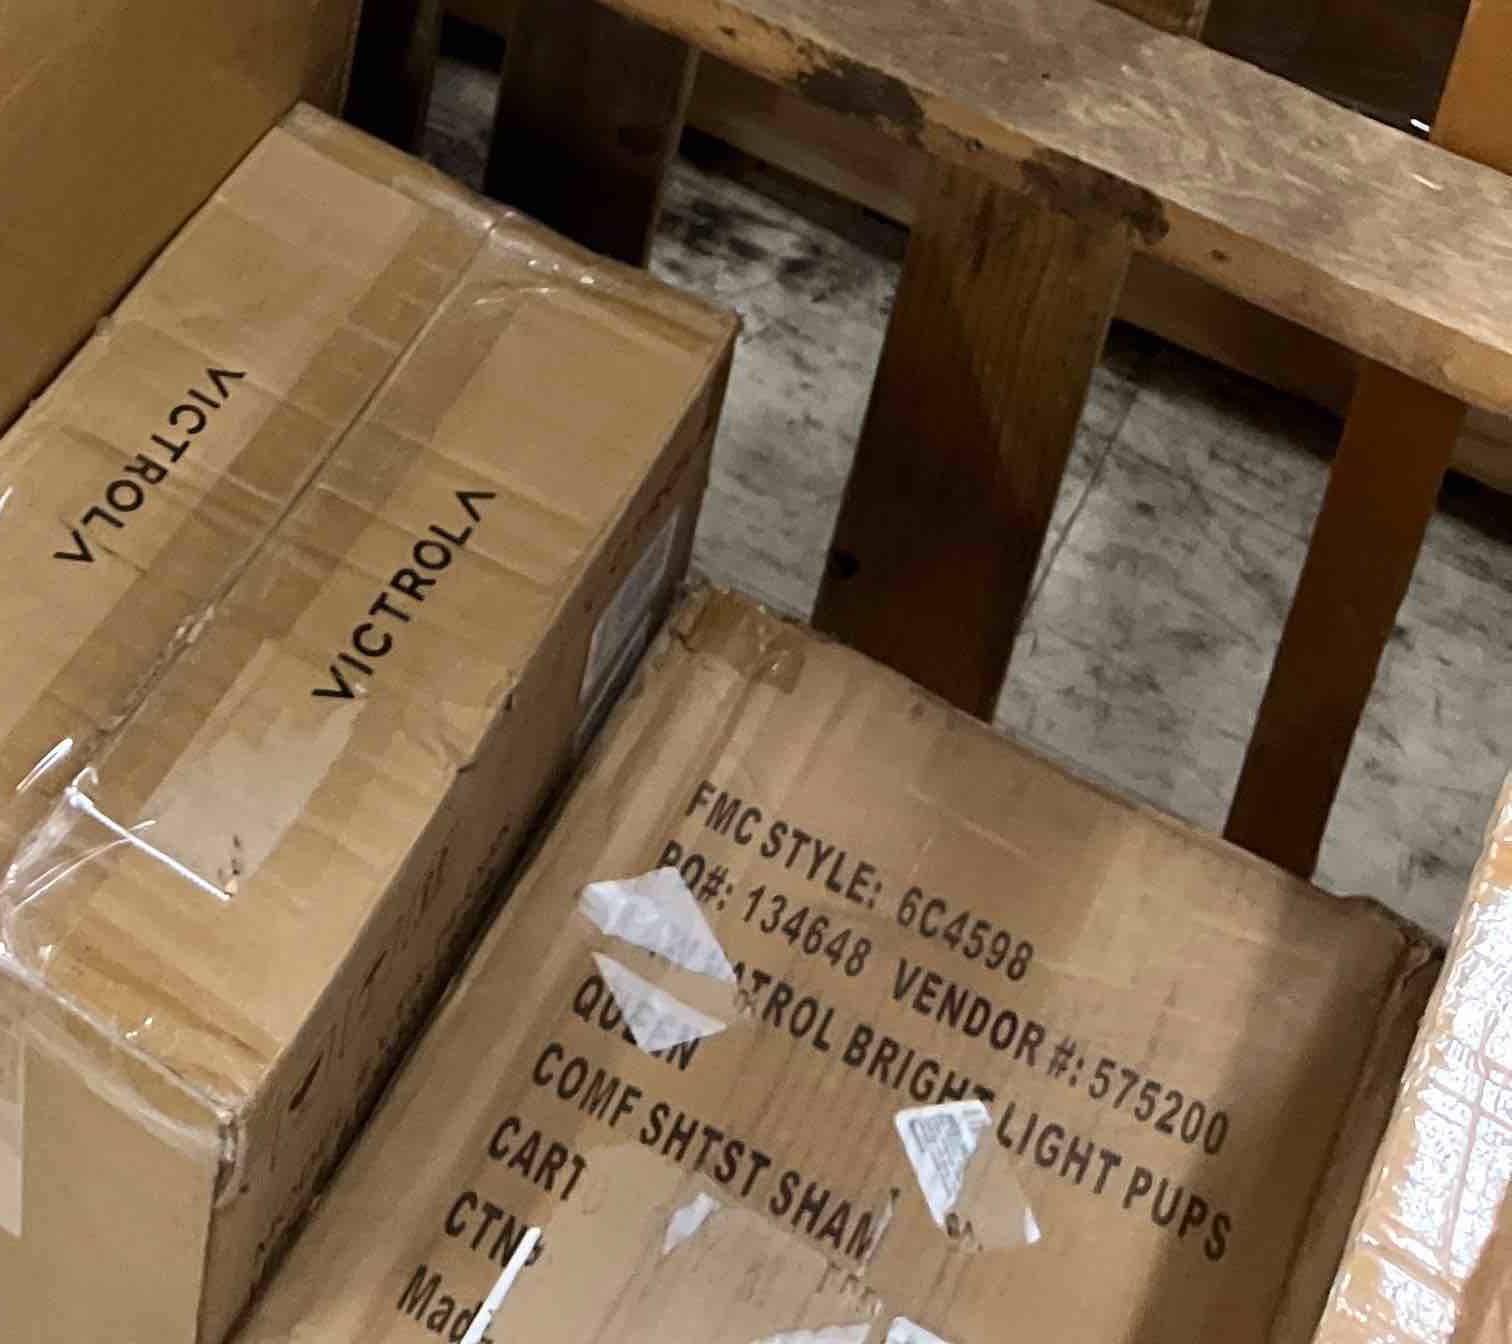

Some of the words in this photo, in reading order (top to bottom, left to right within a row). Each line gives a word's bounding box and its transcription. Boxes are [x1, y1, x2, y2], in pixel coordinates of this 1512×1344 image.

[54, 367, 245, 565] VICTROLA
[312, 487, 496, 700] VICTROLA
[687, 779, 758, 846] FMC
[758, 821, 883, 910] STYLE:
[895, 884, 1035, 982] 6C4598
[530, 1042, 643, 1131] COMF
[640, 1098, 769, 1192] SHTST
[740, 884, 872, 978] 134648
[891, 957, 1044, 1062] VENDOR
[1087, 1056, 1230, 1156] 575200
[997, 1092, 1122, 1192] LIGHT
[1122, 1166, 1233, 1262] PUPS
[396, 1264, 496, 1344] Mad
